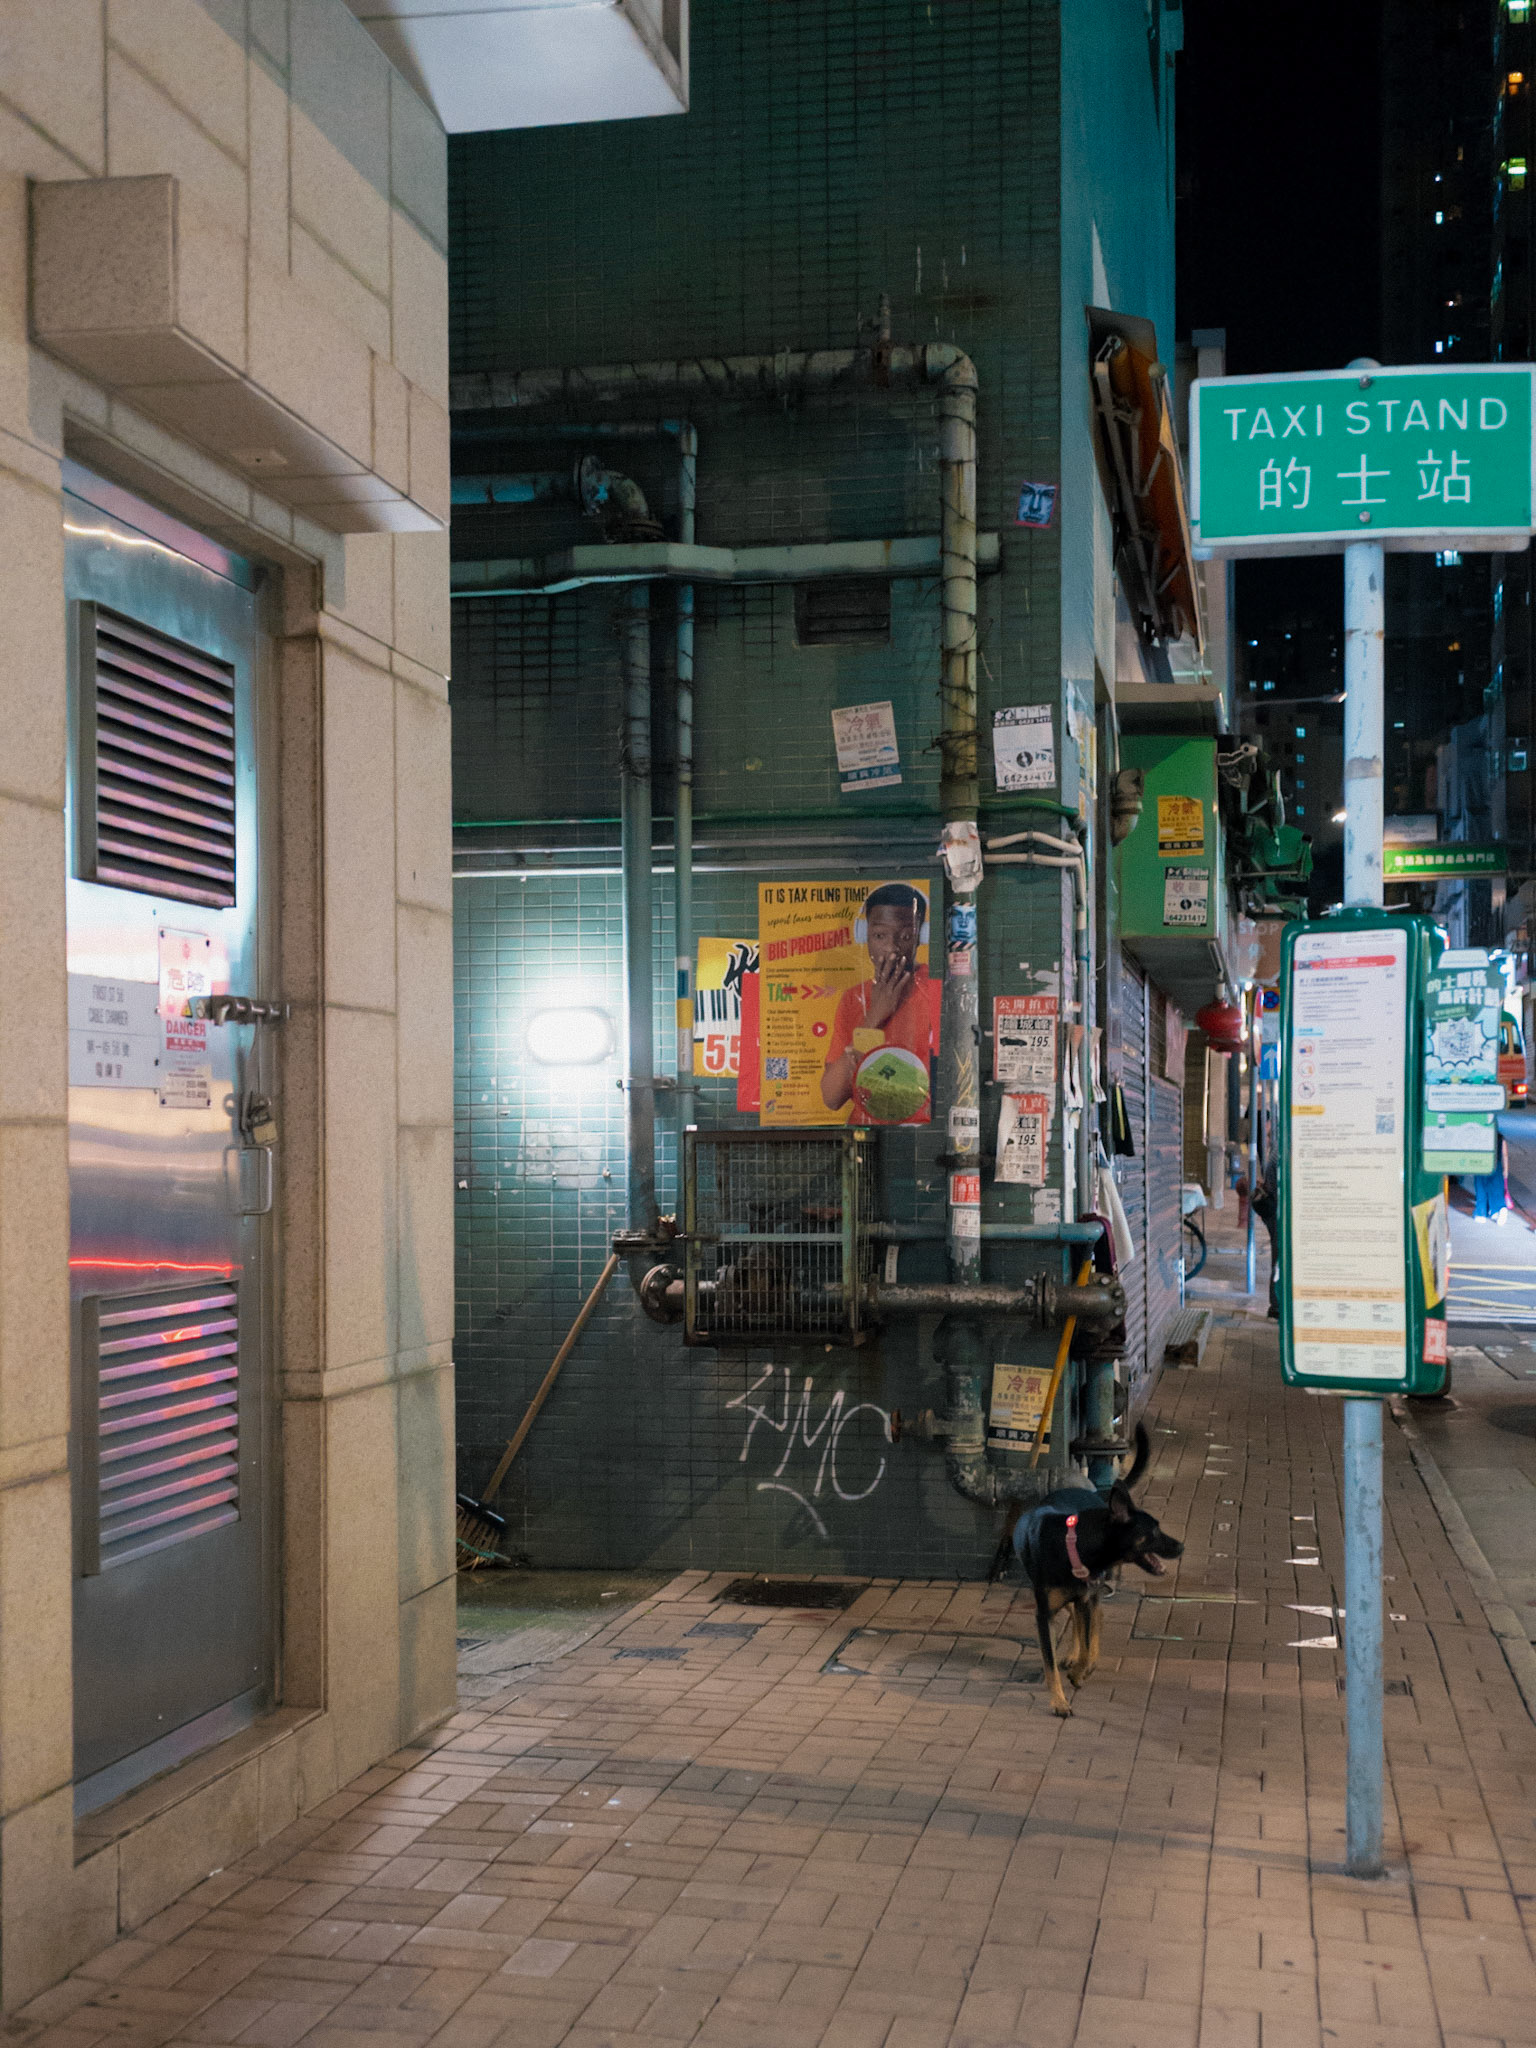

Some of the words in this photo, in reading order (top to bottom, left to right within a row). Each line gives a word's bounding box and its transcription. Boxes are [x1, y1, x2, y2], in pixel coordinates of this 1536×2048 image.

[1224, 404, 1323, 441] TAXI
[1345, 398, 1508, 435] STAND
[1260, 449, 1471, 511] 的士站
[765, 888, 773, 904] IT
[776, 888, 785, 904] IS
[788, 887, 808, 904] TAX
[810, 887, 841, 903] FILING
[844, 886, 869, 902] TIME!
[1169, 914, 1206, 922] 64231417
[1239, 921, 1279, 936] STOP
[767, 941, 788, 961] BIG
[790, 926, 852, 957] PROBLEM!
[767, 983, 793, 1003] TAX
[166, 1019, 207, 1037] DANGER
[1007, 1374, 1042, 1395] 冷氣
